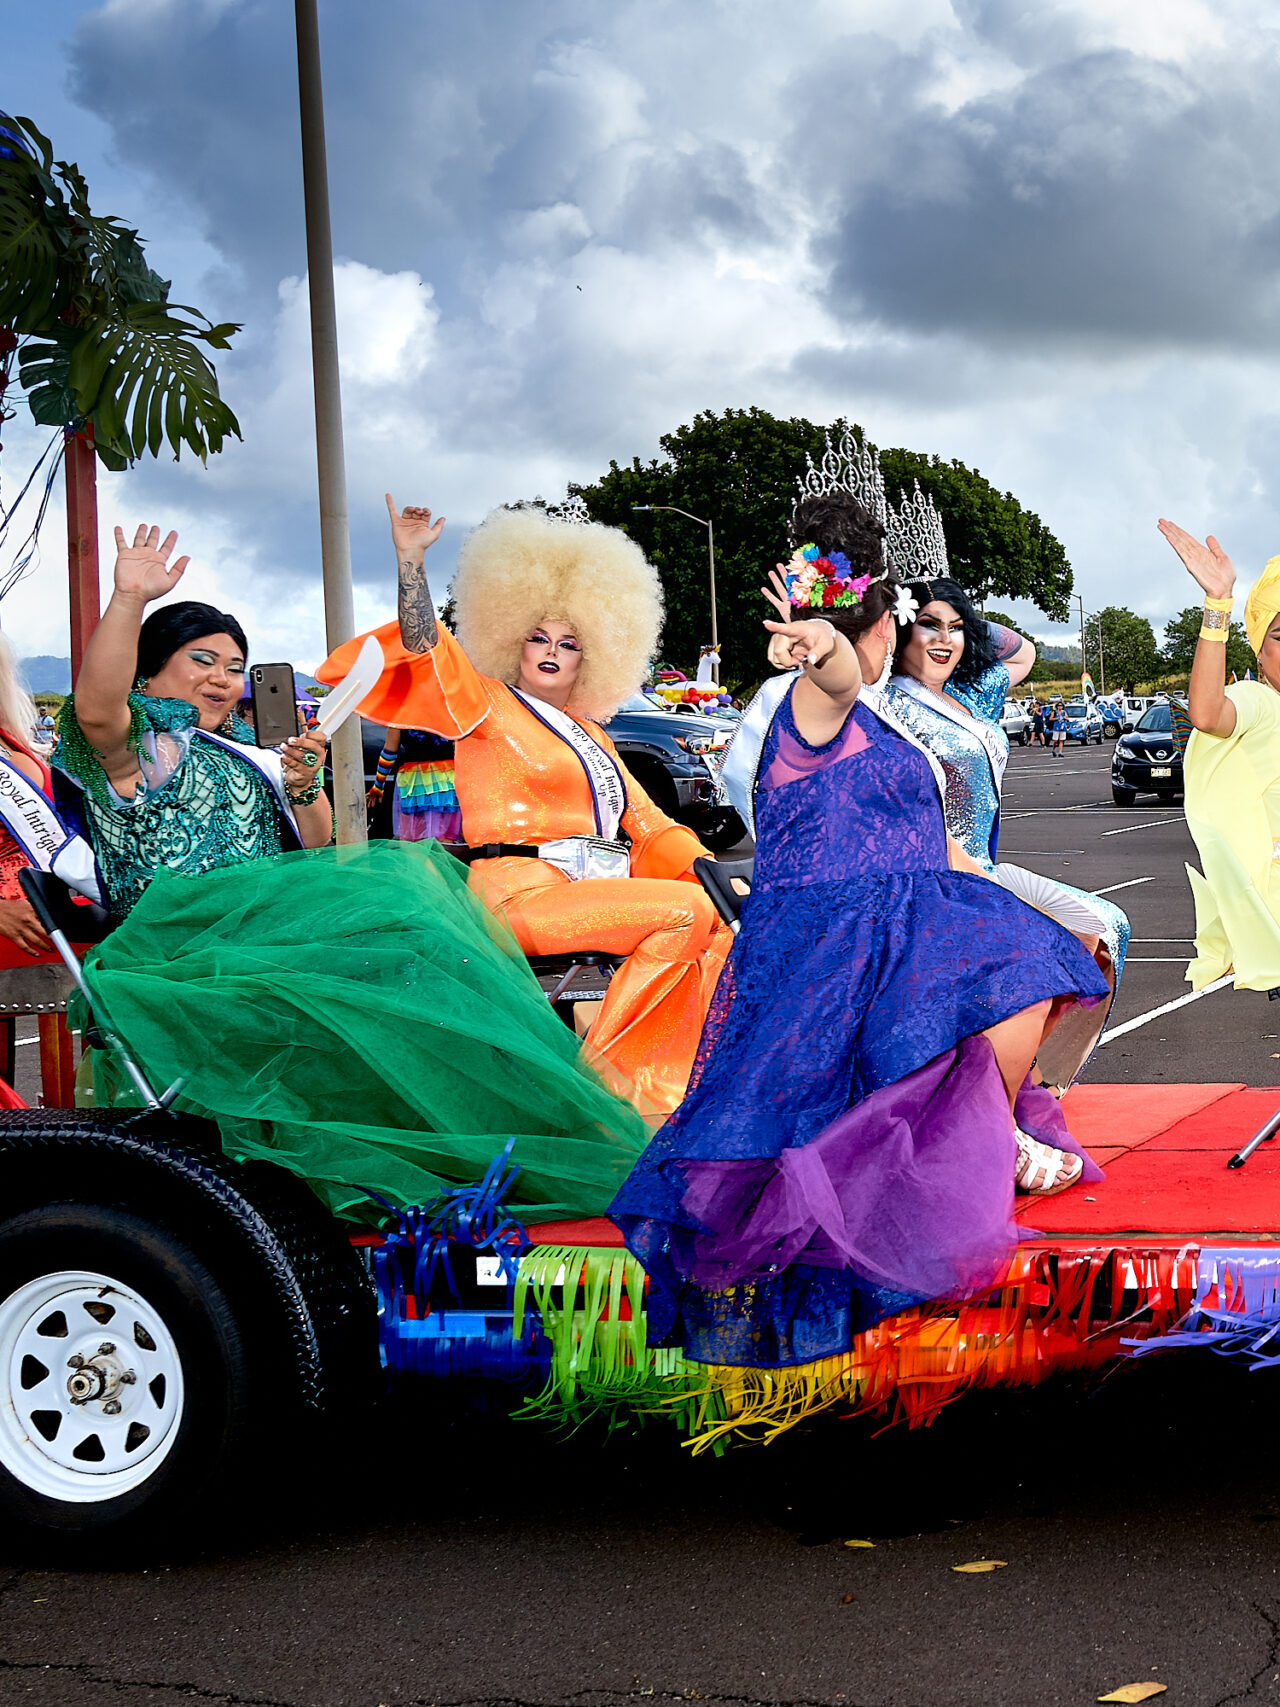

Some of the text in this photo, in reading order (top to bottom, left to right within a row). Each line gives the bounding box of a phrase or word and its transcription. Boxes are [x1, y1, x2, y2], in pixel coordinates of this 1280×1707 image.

[0, 769, 59, 854] Royal Intrigu
[605, 775, 621, 814] Intrigue
